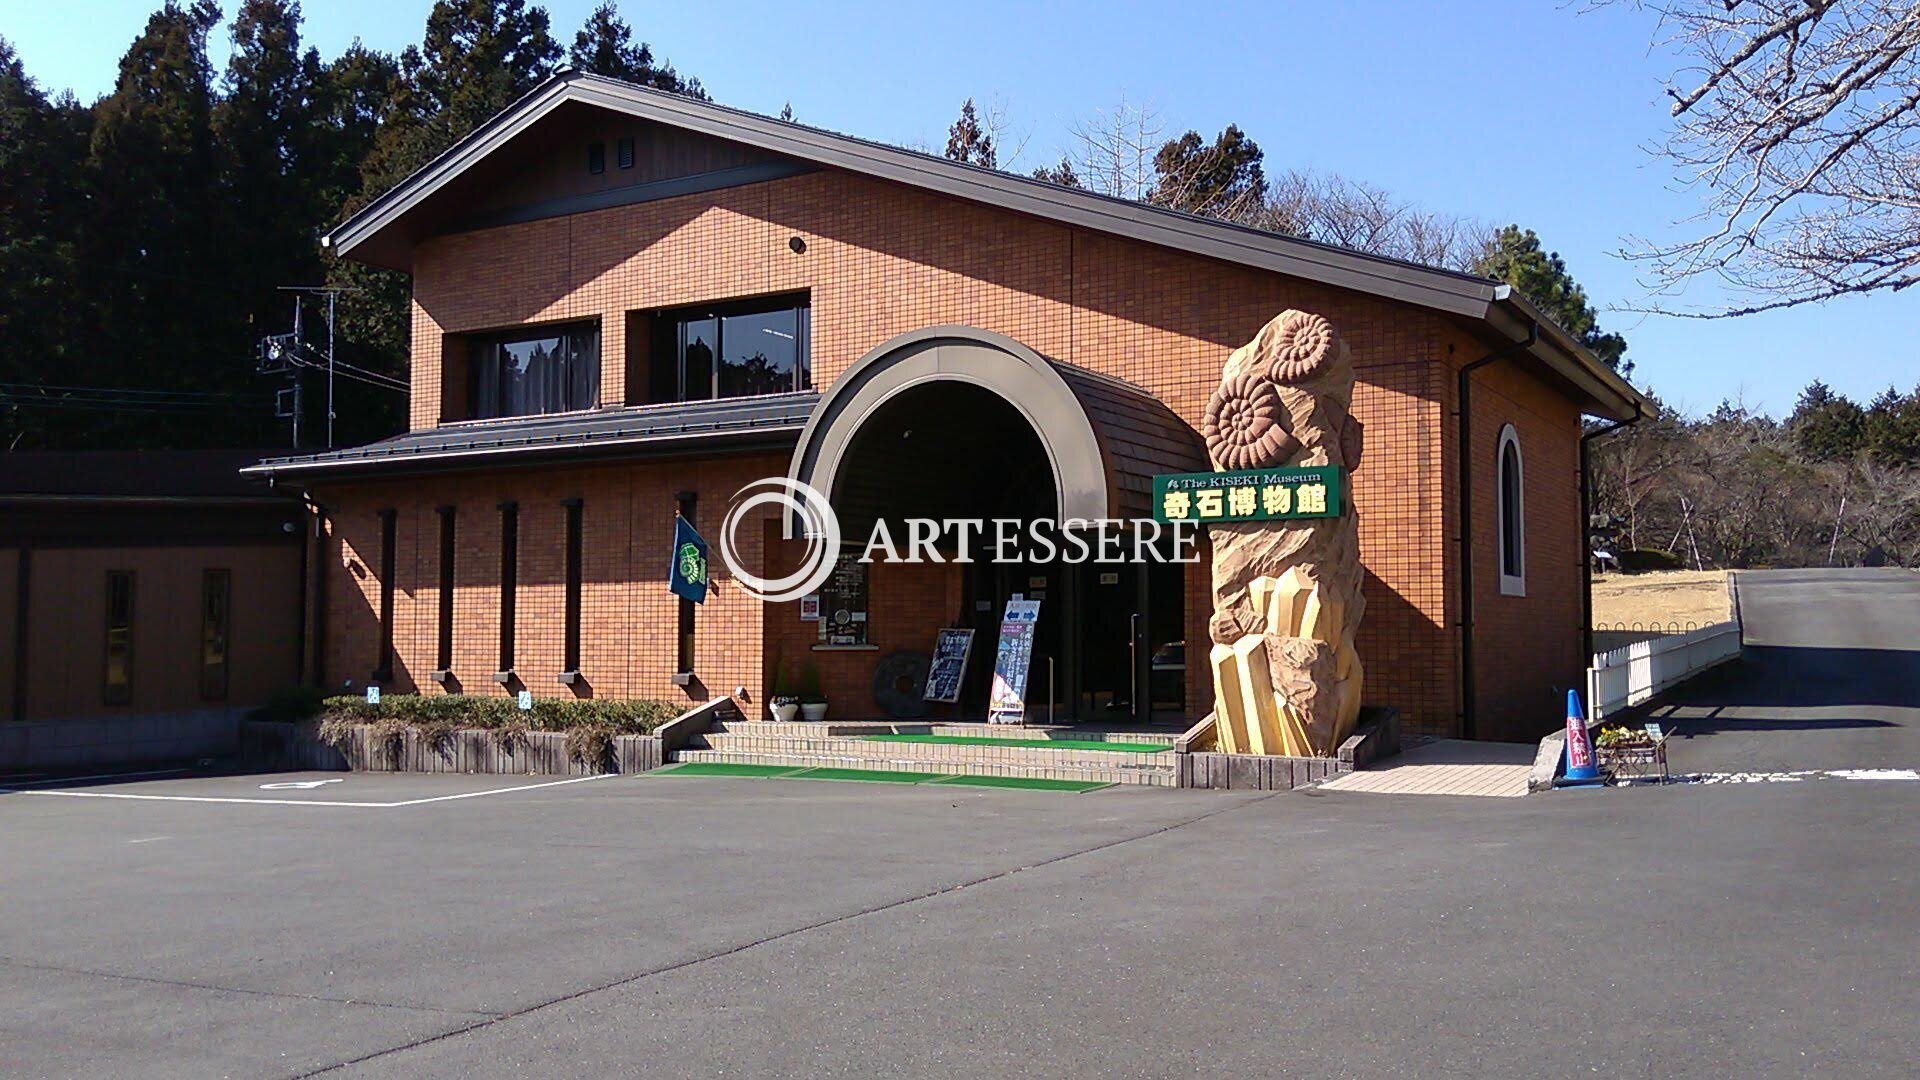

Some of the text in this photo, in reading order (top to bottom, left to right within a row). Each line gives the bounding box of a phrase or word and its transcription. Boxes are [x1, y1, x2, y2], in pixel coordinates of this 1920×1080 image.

[1181, 473, 1321, 489] The KISEKI Museum
[1163, 484, 1326, 518] 奇石博物館
[1569, 717, 1588, 766] 進入禁止
